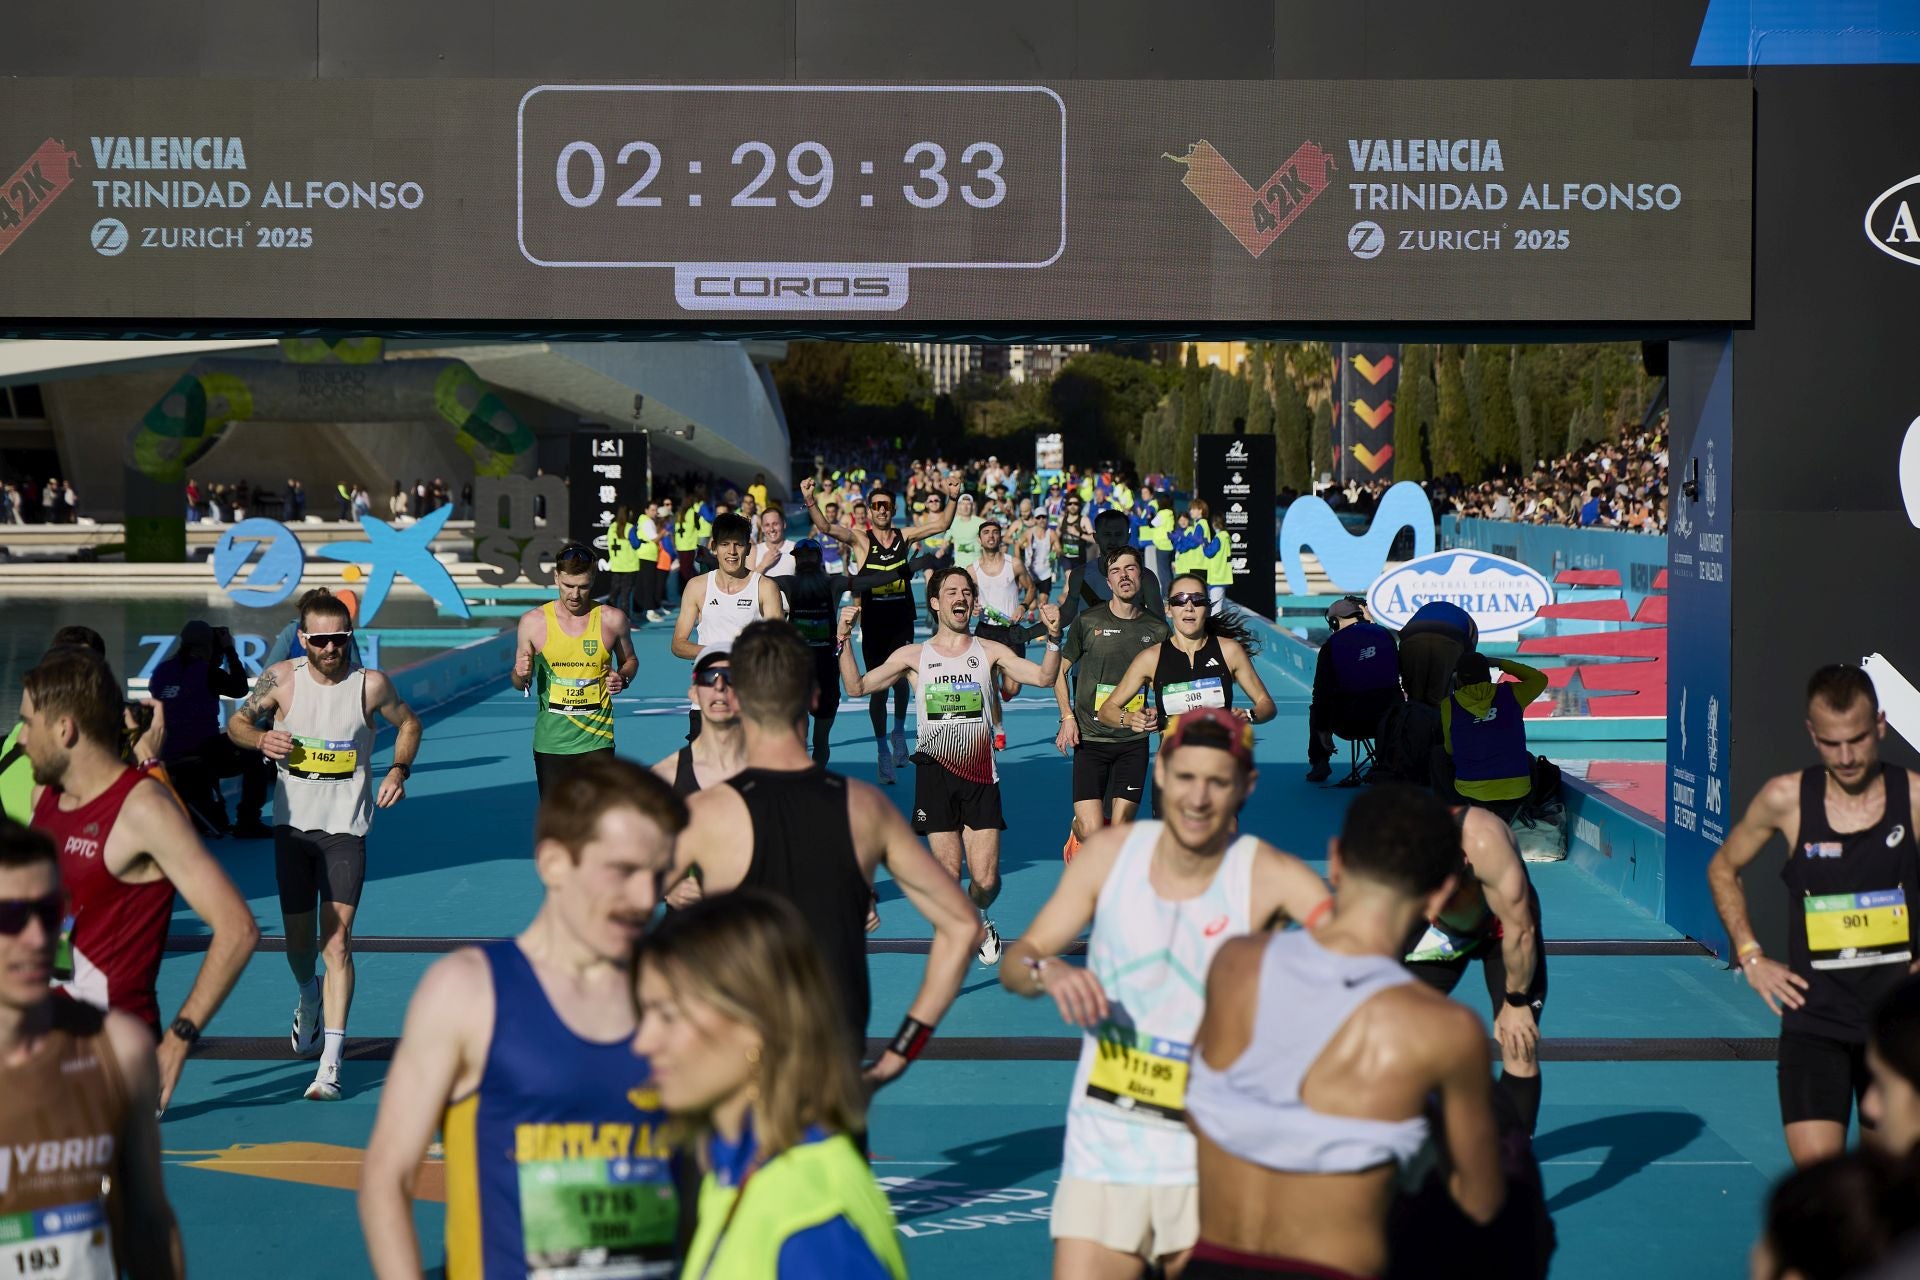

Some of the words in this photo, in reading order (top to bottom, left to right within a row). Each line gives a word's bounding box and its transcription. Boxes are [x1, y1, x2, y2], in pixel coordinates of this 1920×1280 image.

[90, 136, 247, 170] VALENCIA
[1348, 139, 1504, 172] VALENCIA
[92, 181, 250, 208] TRINIDAD
[261, 180, 424, 210] ALFONSO
[1252, 166, 1314, 235] 42K
[1349, 183, 1507, 211] TRINIDAD
[1518, 182, 1682, 211] ALFONSO
[141, 226, 245, 249] ZURICH
[257, 227, 313, 249] 2025
[1398, 229, 1501, 251] ZURICH
[1513, 229, 1570, 251] 2025
[693, 276, 890, 298] COROS
[1412, 581, 1470, 589] CENTRAL
[1474, 580, 1530, 589] LECHERA
[934, 673, 972, 684] URBAN
[566, 688, 585, 697] 1238
[944, 693, 961, 703] 739
[1185, 692, 1202, 703] 308
[940, 704, 966, 712] William
[311, 751, 336, 762] 1462
[64, 836, 99, 859] PPTC
[1843, 914, 1870, 928] 901
[896, 1206, 1052, 1238] ZURIC
[15, 1246, 60, 1274] 193
